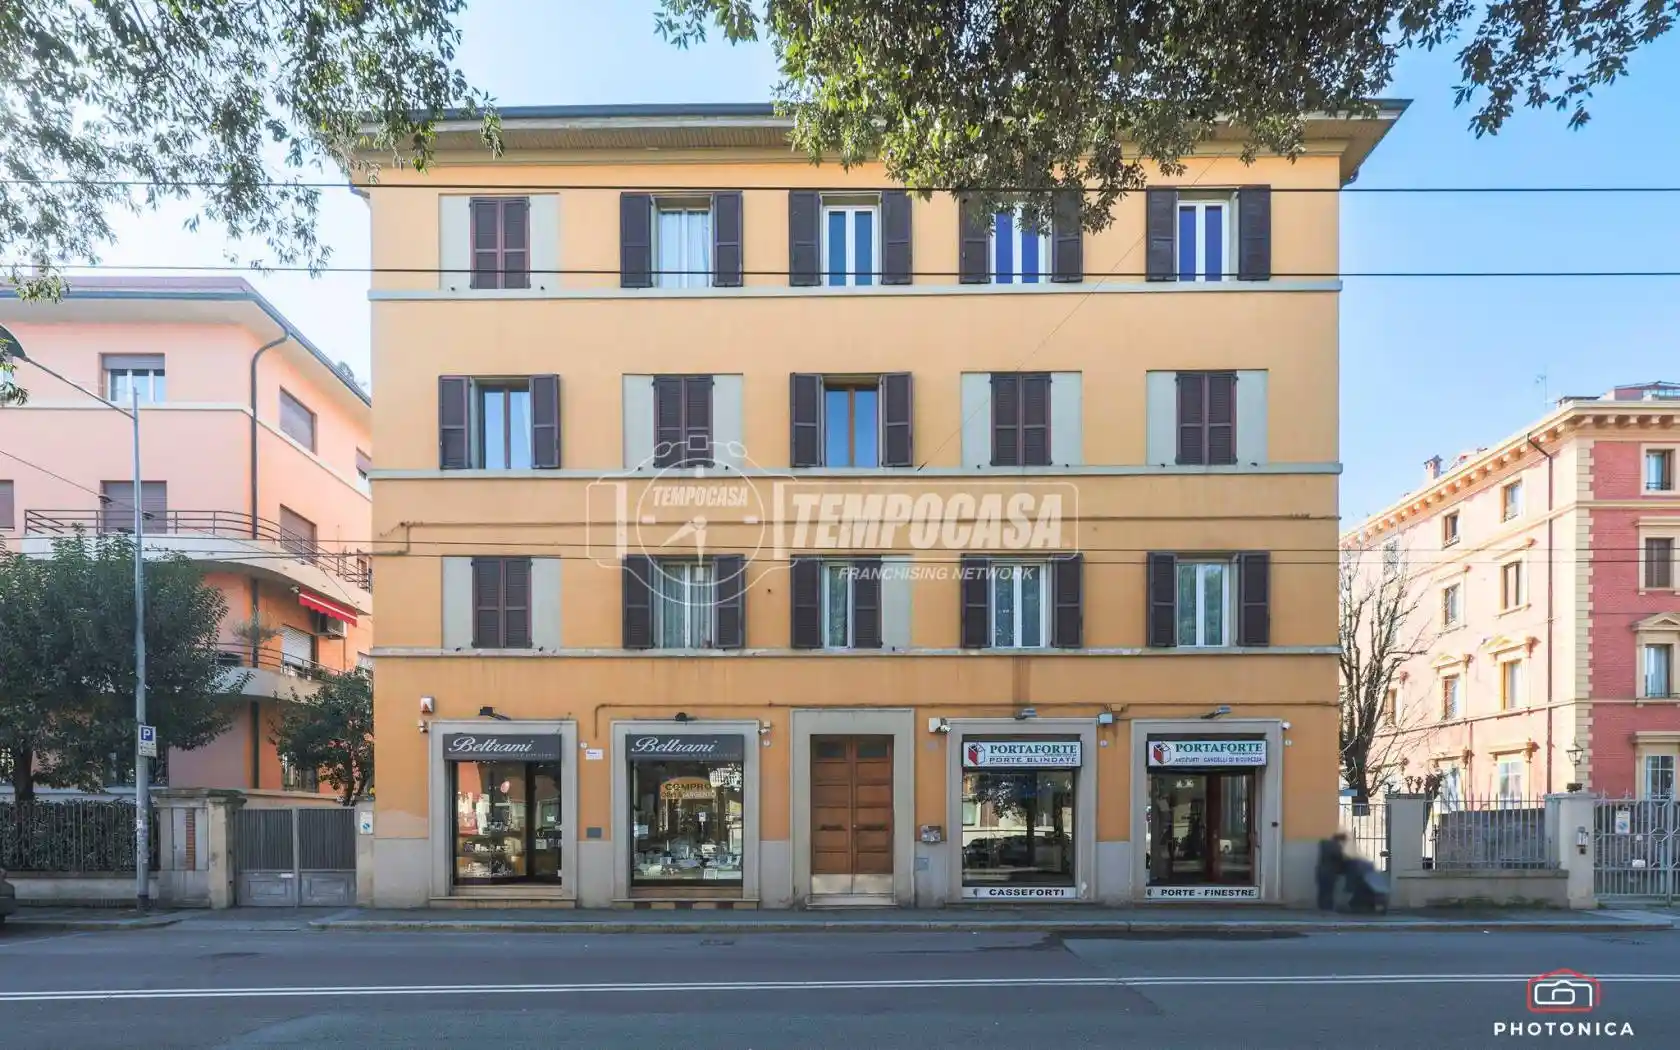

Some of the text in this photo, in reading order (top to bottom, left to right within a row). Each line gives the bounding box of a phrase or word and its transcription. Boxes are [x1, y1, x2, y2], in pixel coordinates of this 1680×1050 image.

[143, 728, 151, 740] P
[448, 736, 535, 753] Beltrami
[631, 736, 718, 753] Beltrami
[1175, 743, 1263, 753] PORTAFORTE
[989, 745, 1078, 754] PORTAFORTE
[664, 783, 712, 792] COMPRO
[989, 888, 1065, 897] CASSEFORTI
[1161, 889, 1196, 897] PORTE
[1204, 889, 1256, 897] FINESTRE
